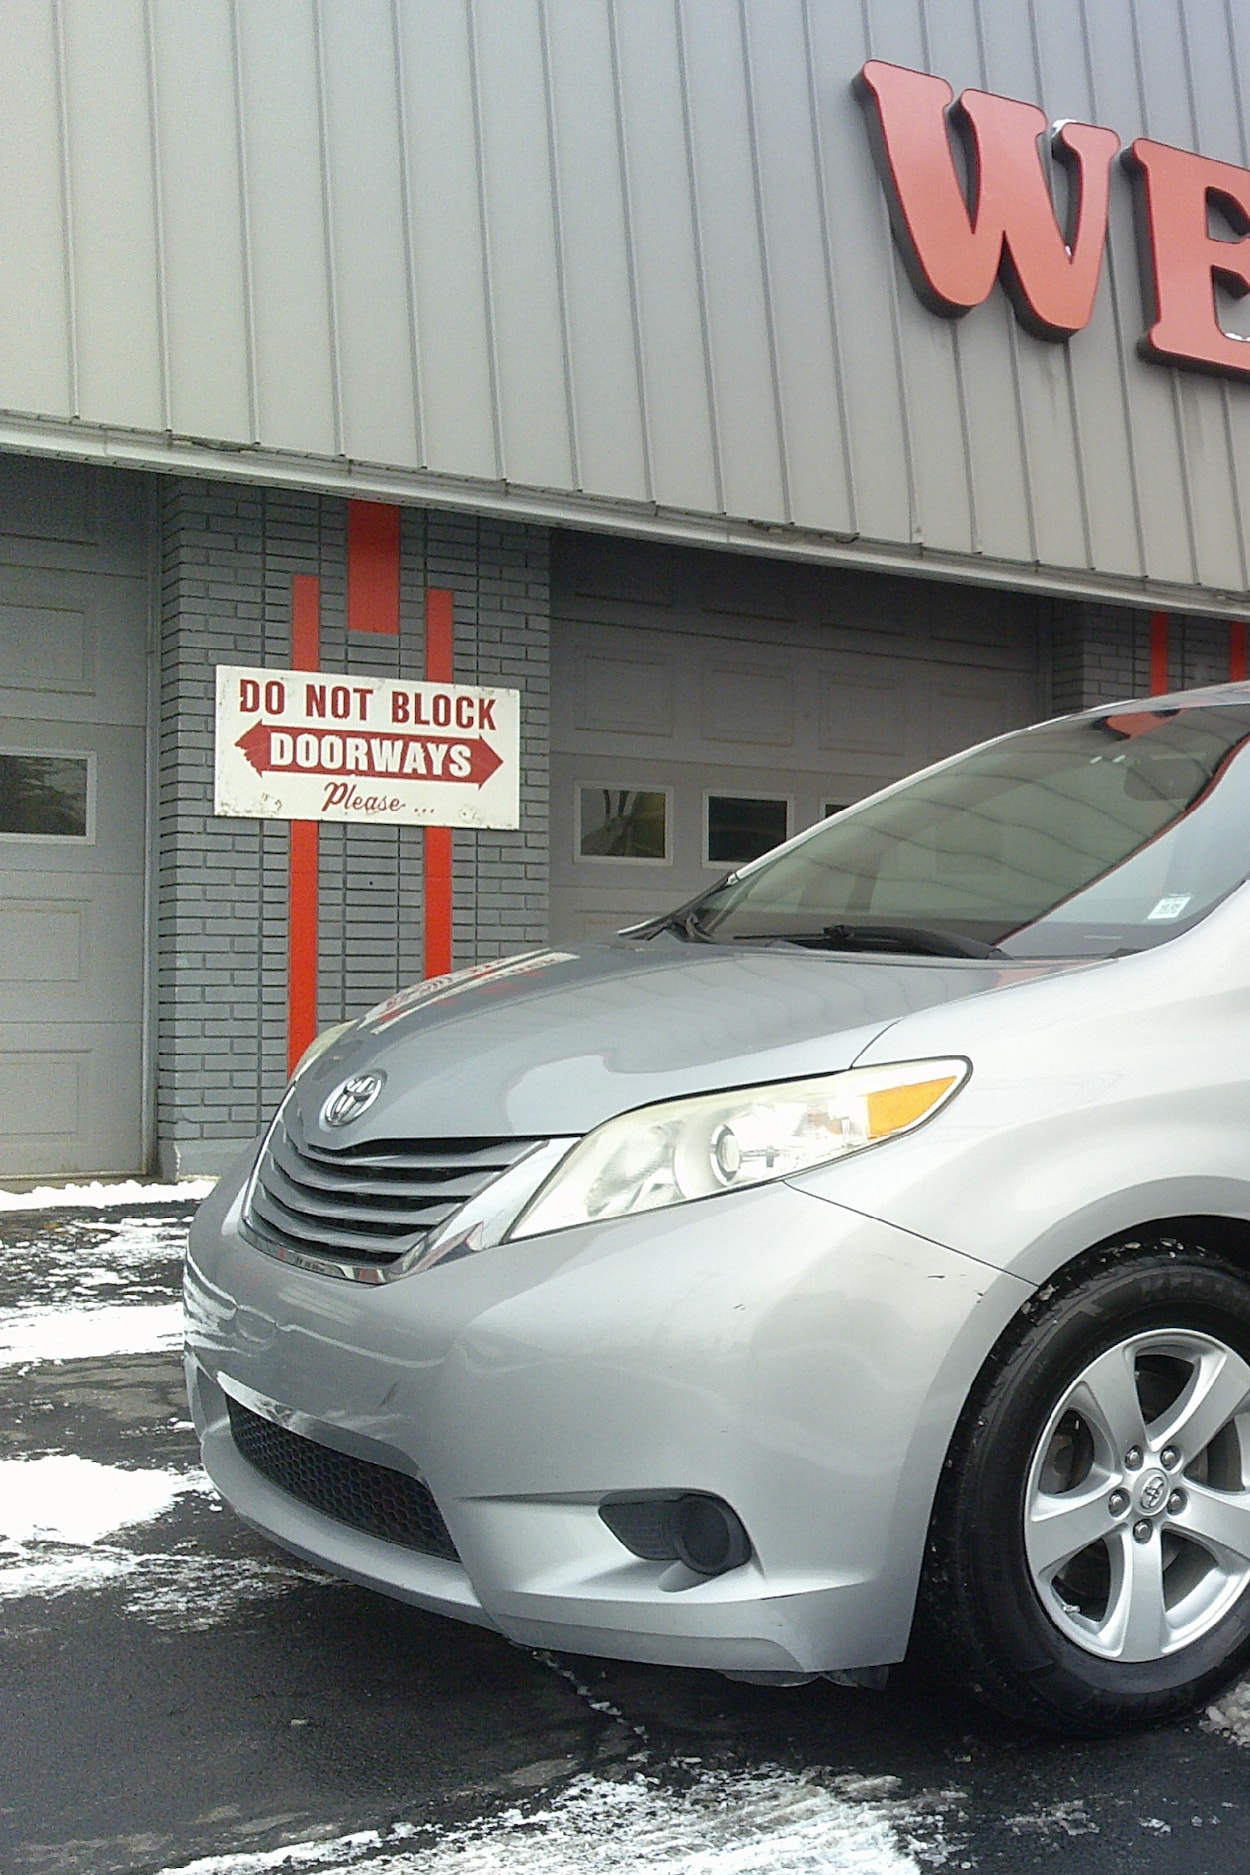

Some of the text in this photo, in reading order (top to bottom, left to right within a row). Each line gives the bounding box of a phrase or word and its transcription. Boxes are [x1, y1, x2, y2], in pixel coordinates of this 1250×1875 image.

[240, 679, 496, 730] DO NOT BLOCK
[270, 731, 472, 778] DOORWAYS
